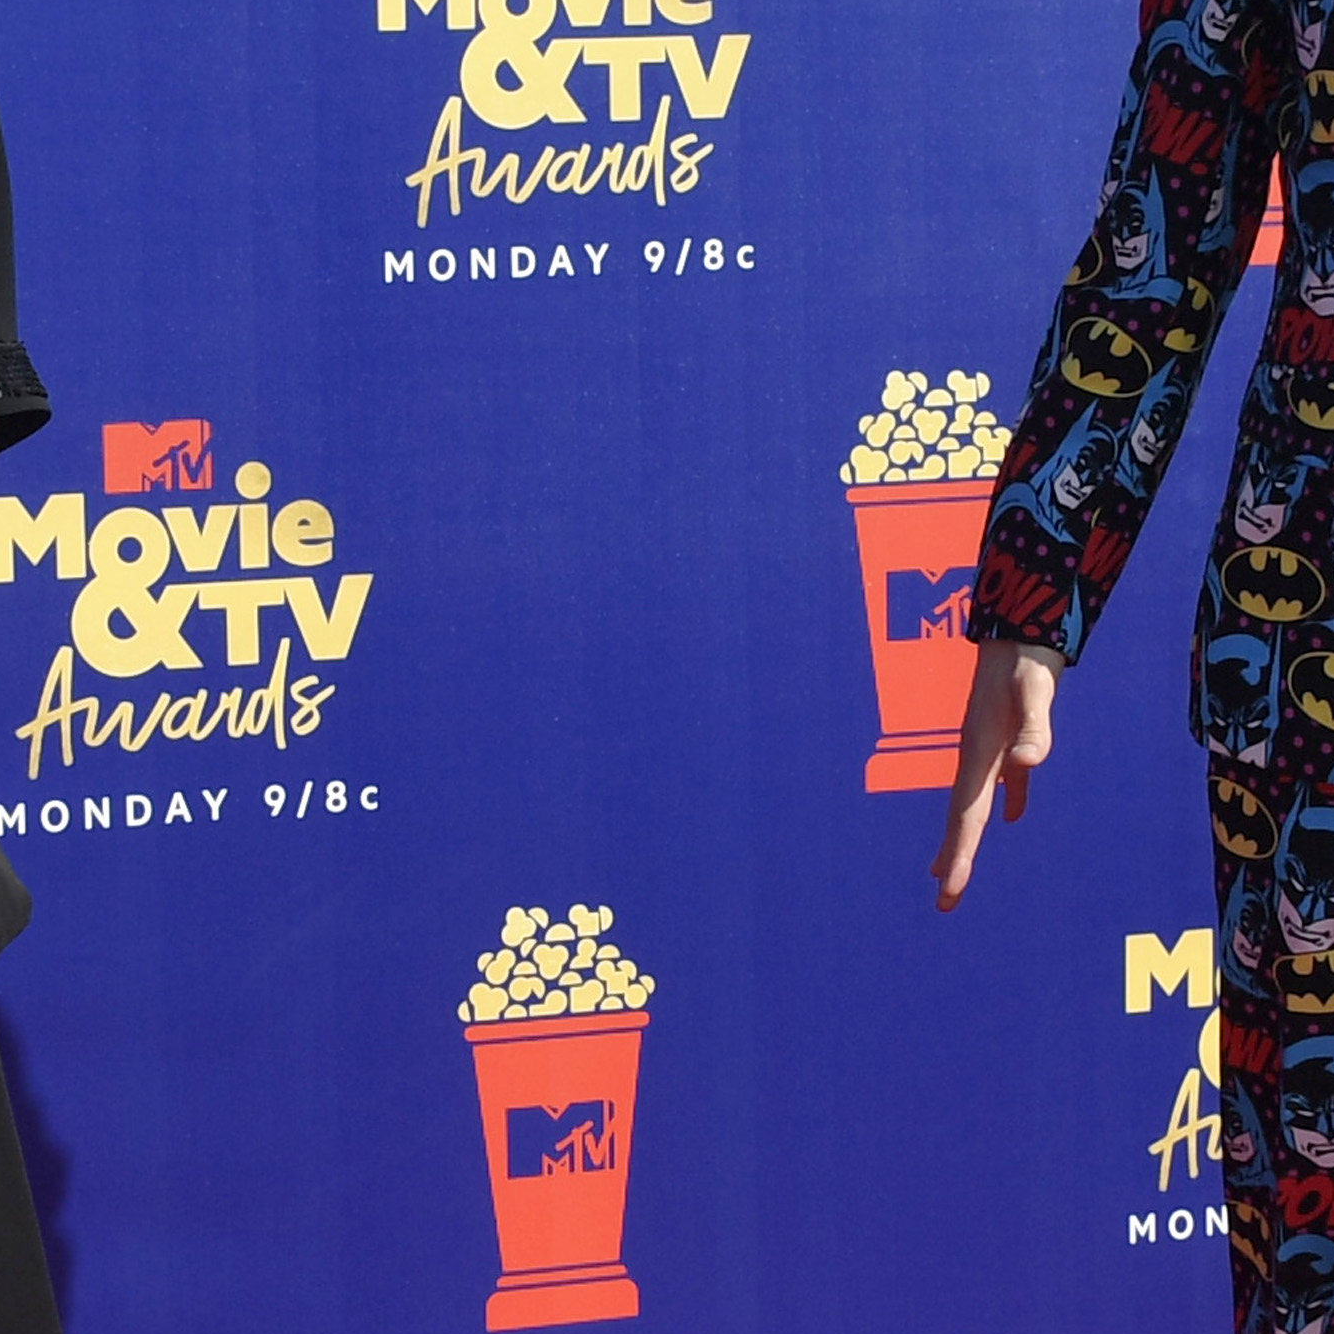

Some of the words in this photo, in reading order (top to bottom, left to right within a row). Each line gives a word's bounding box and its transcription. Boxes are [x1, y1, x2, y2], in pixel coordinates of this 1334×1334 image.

[405, 95, 714, 229] Awards
[383, 243, 610, 284] MONDAY
[643, 237, 755, 276] 9/8c
[102, 419, 213, 494] MTV
[15, 637, 336, 780] Awards
[264, 780, 379, 819] 9/8c
[504, 1098, 616, 1180] MTV
